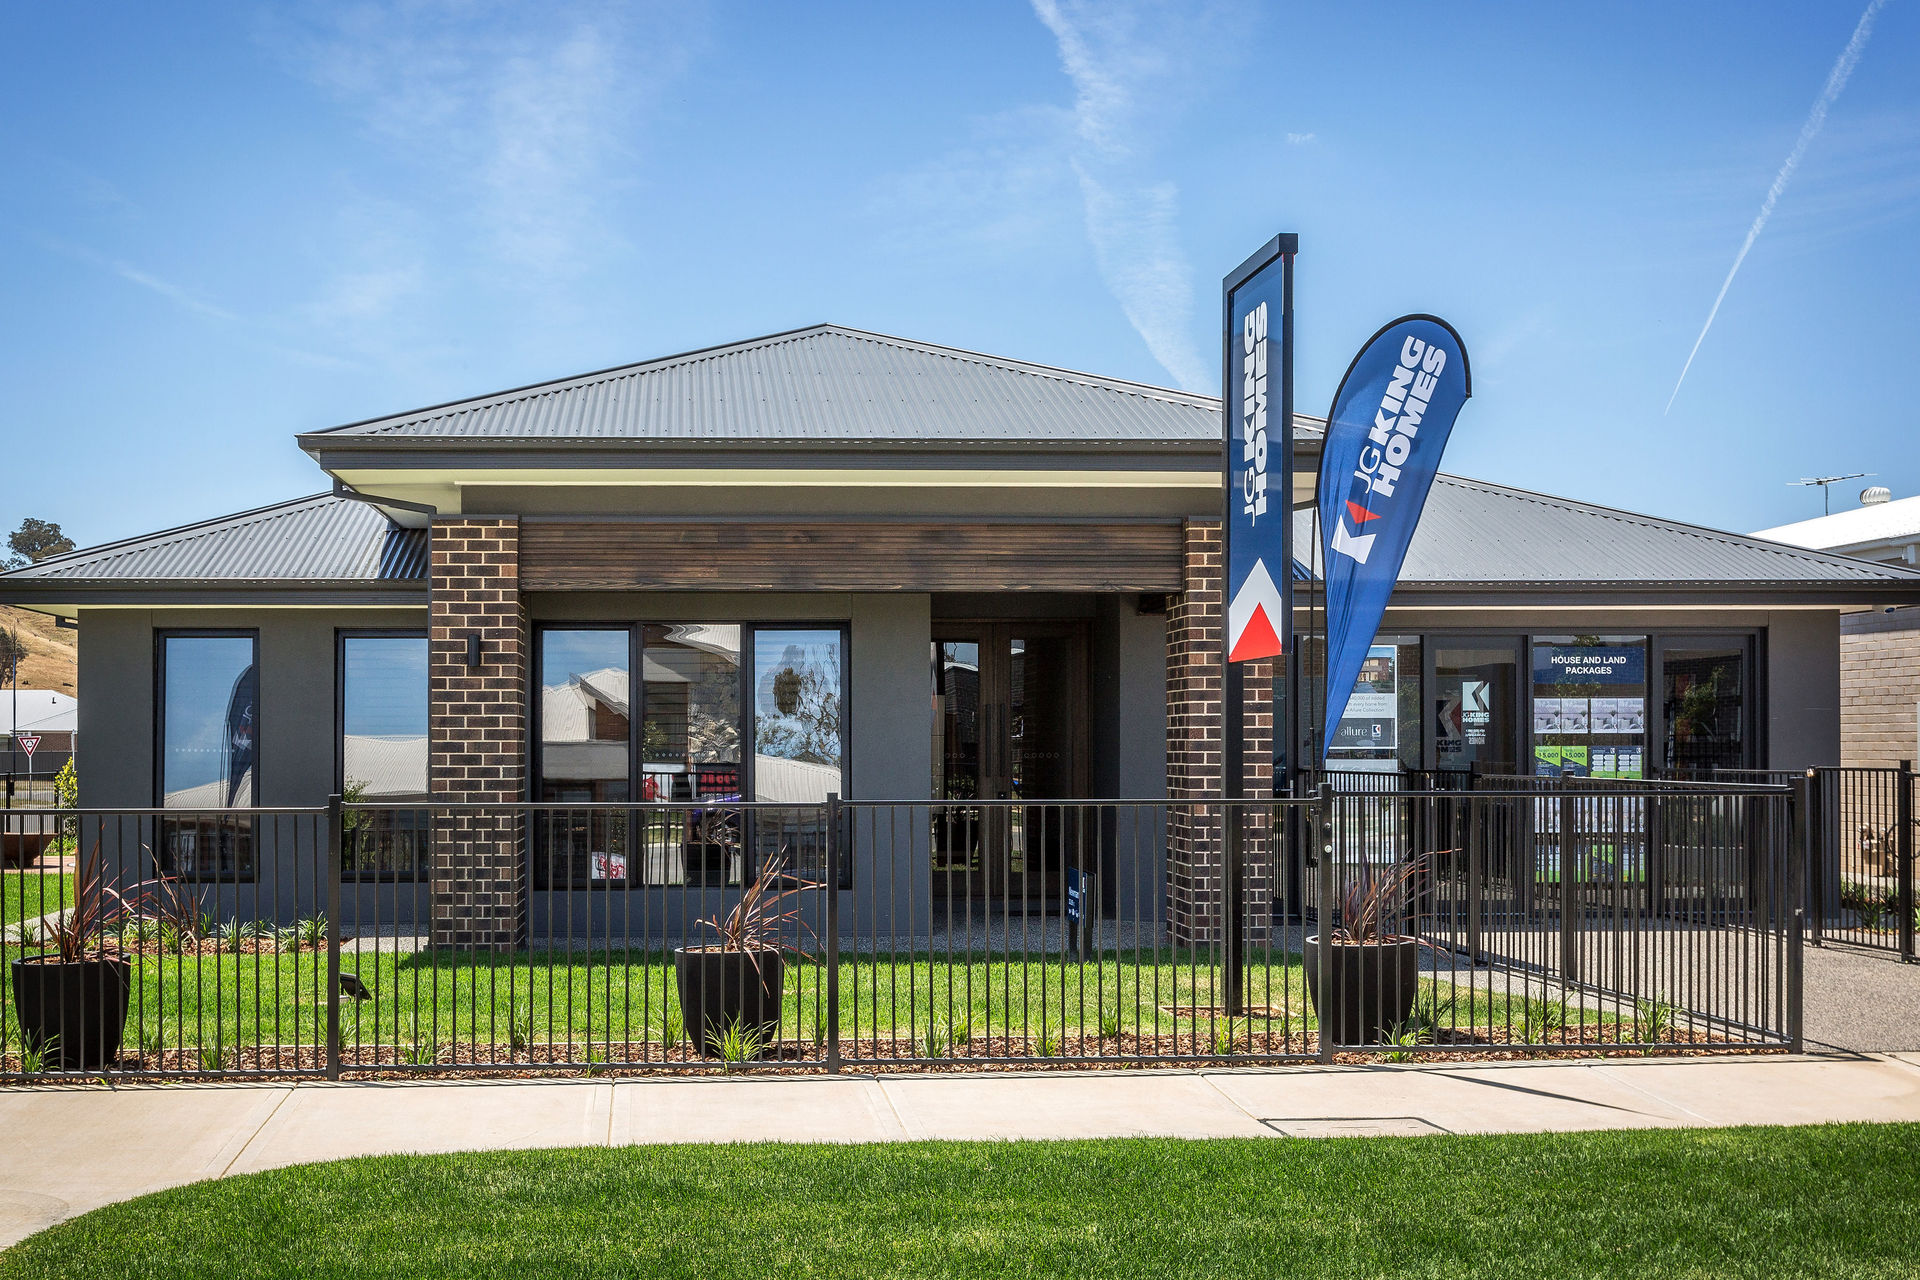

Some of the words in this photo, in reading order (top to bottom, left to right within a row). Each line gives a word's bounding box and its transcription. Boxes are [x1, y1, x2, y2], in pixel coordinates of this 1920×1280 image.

[1255, 301, 1268, 517] HOMES
[1371, 345, 1447, 498] HOMES
[1551, 656, 1580, 664] HOUSE
[1583, 656, 1601, 664] AND
[1603, 656, 1627, 664] LAND
[1565, 666, 1612, 674] PACKAGES
[1340, 726, 1368, 736] allure
